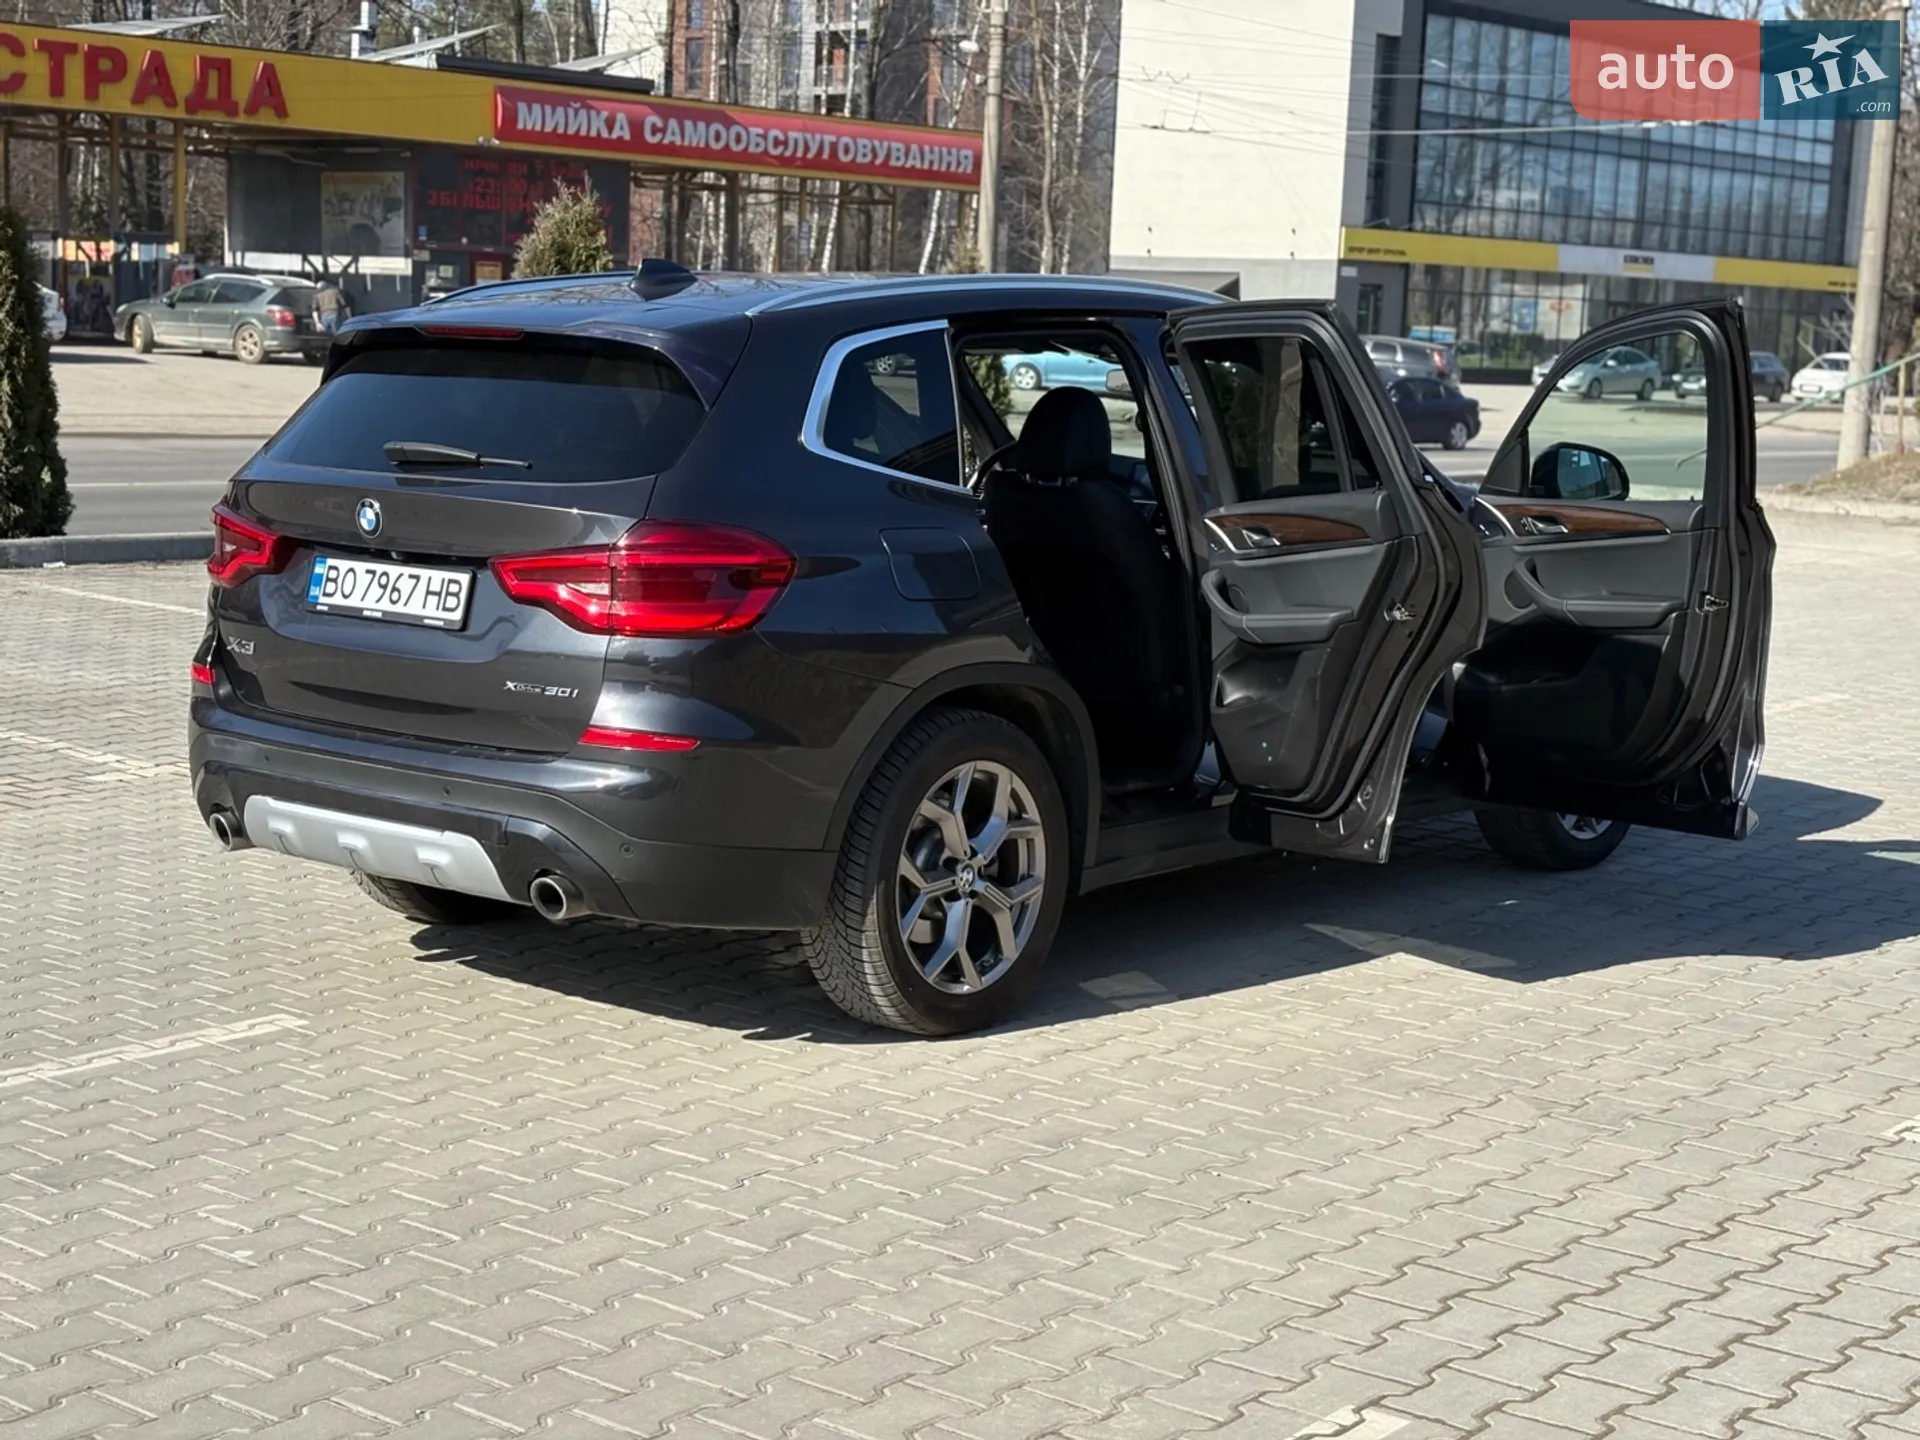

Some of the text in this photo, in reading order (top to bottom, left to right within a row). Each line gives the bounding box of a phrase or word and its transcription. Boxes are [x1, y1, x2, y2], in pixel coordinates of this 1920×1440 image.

[516, 101, 632, 141] МИЙКА
[643, 115, 975, 174] САМООБСЛУГОВУВАННЯ
[360, 569, 421, 607] 7967
[226, 635, 256, 655] X3
